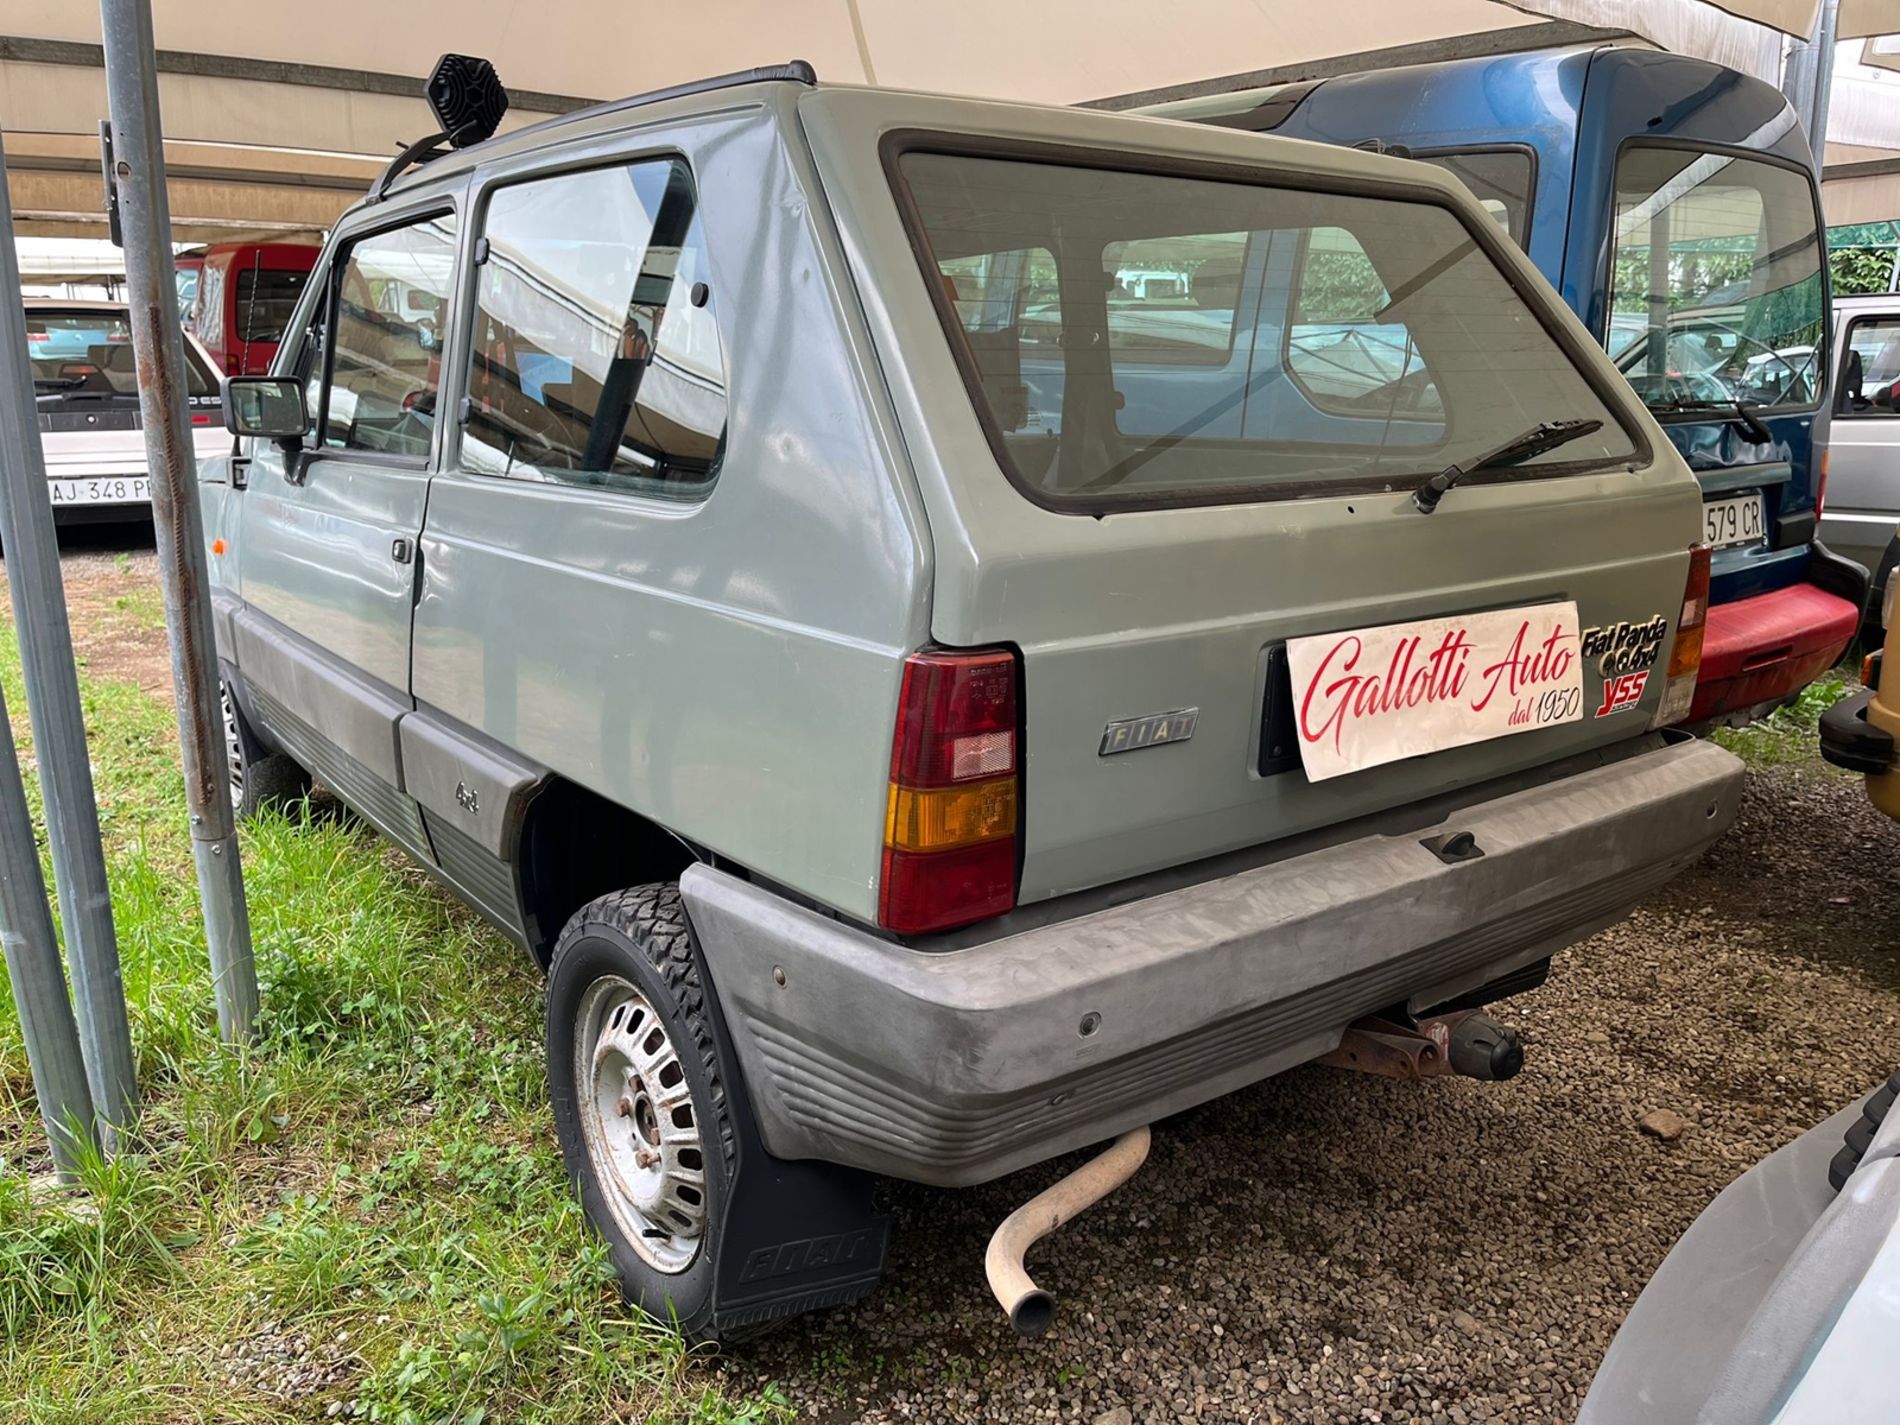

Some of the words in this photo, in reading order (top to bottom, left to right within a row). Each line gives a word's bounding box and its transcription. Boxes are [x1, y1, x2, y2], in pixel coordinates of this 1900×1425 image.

[53, 483, 77, 502] AJ
[88, 481, 127, 500] 348
[1707, 504, 1737, 542] 579
[1742, 501, 1760, 536] CR
[1581, 626, 1616, 658] Fiat
[1613, 614, 1667, 650] Panda
[1300, 635, 1478, 757] Gallotti
[1470, 620, 1579, 712] Auto
[1508, 696, 1534, 727] dal
[1535, 686, 1580, 724] 1950
[1110, 715, 1195, 749] FIAT
[456, 781, 479, 815] 4x4
[748, 1234, 866, 1279] FIAT
